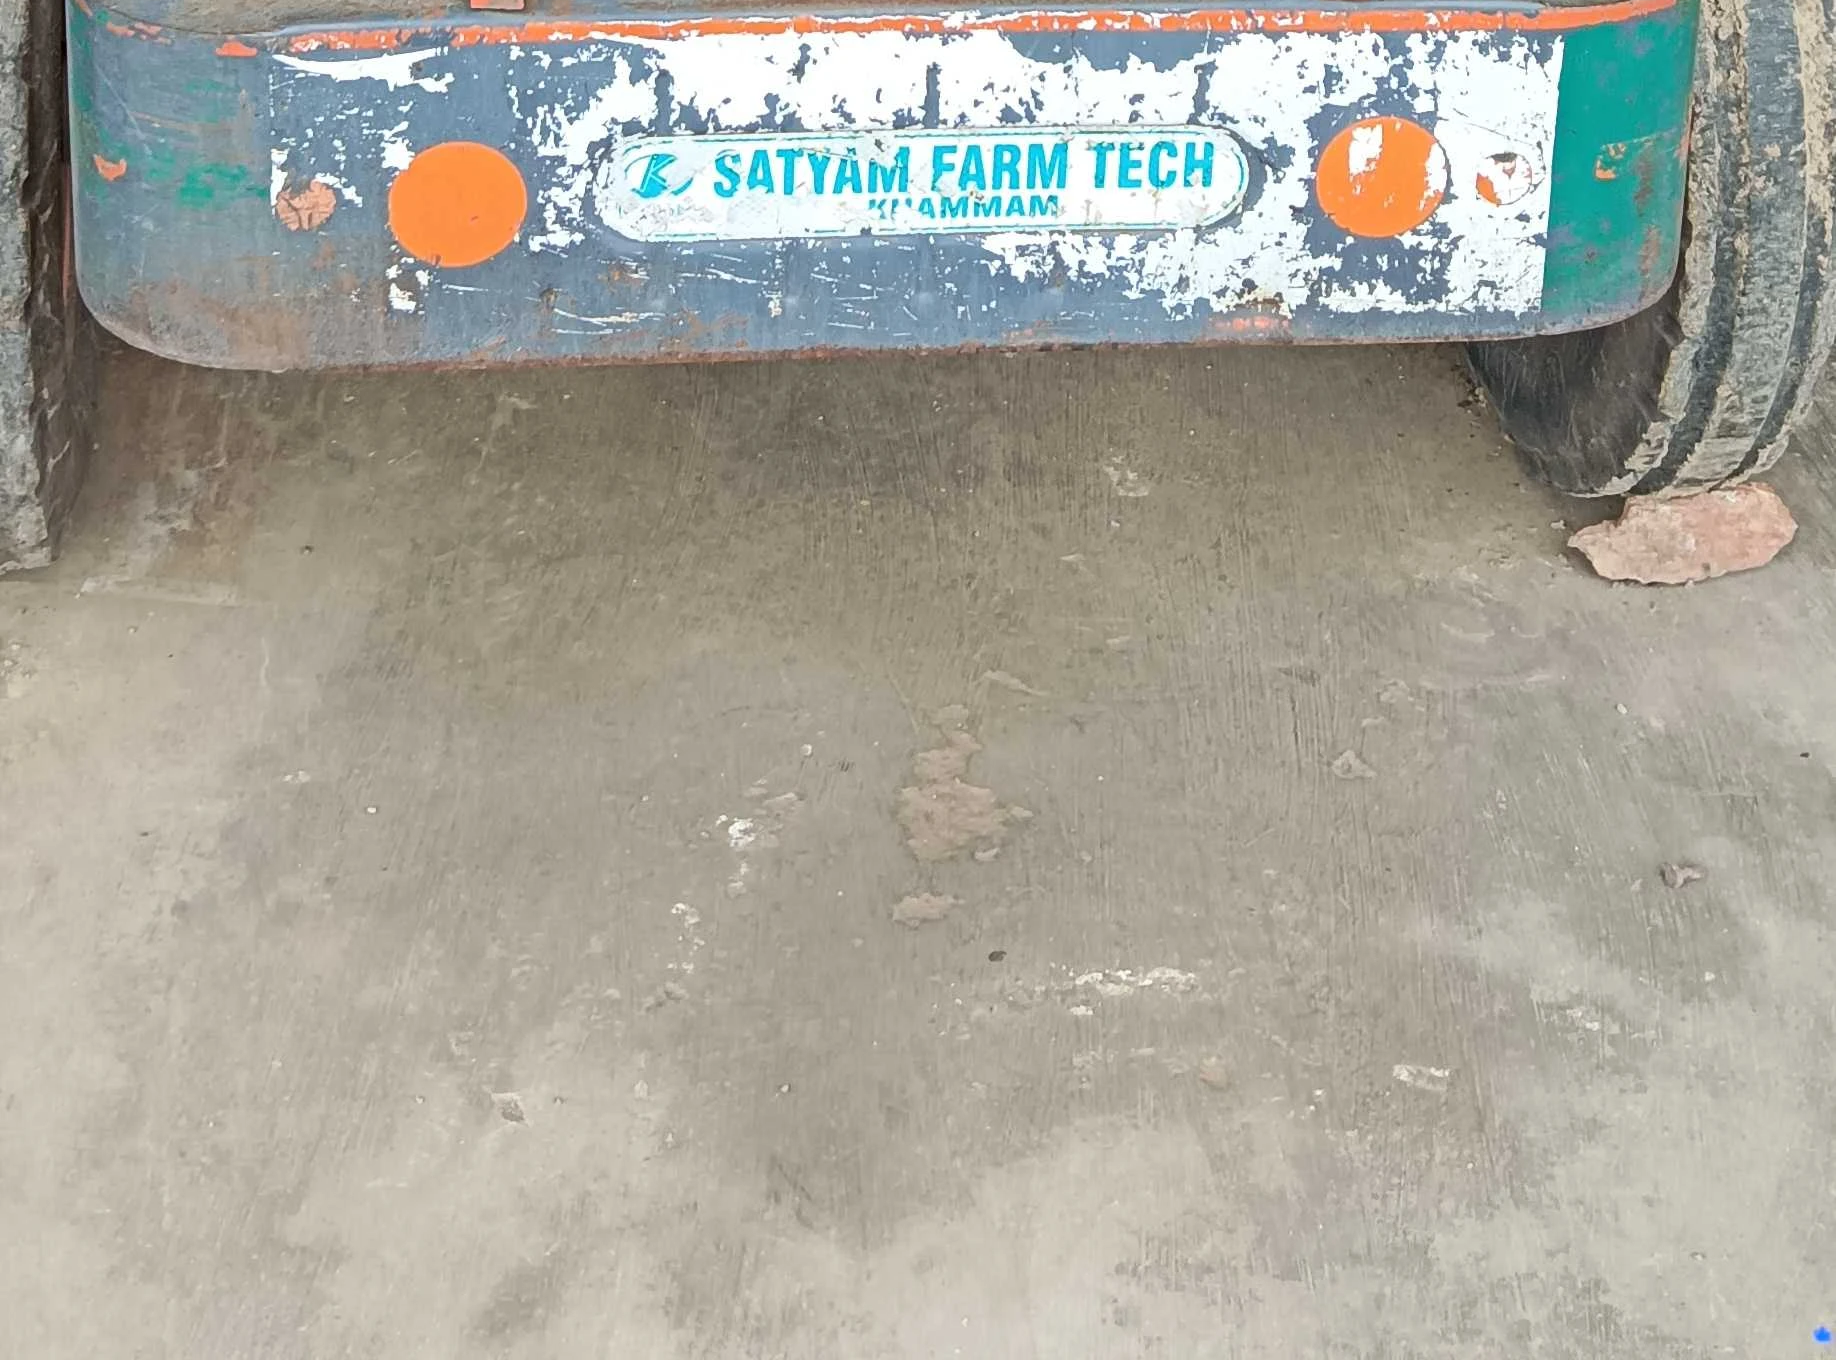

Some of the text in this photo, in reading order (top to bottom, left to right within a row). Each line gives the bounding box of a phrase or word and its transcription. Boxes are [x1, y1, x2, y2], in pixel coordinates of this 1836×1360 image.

[713, 145, 911, 198] SATYAM
[930, 142, 1069, 192] FARM
[1087, 140, 1215, 190] TECH
